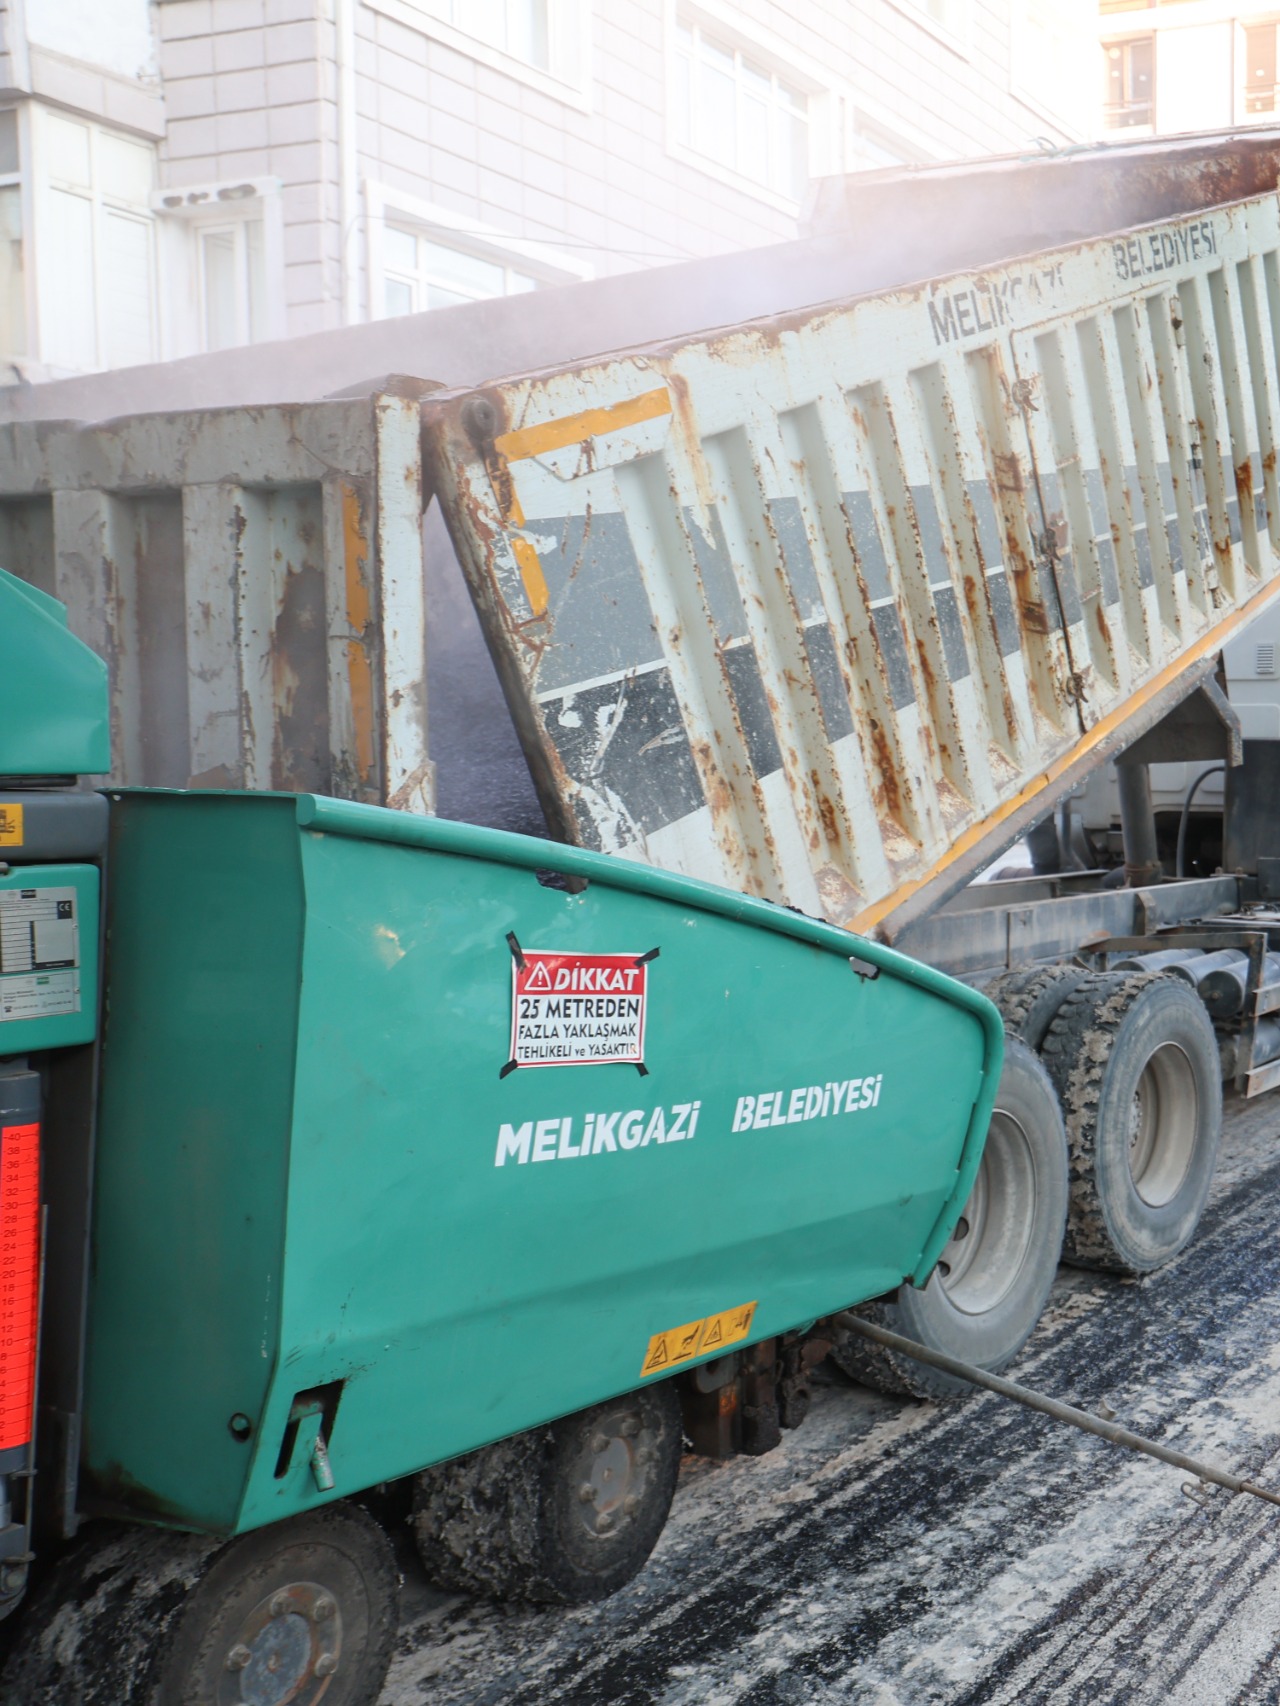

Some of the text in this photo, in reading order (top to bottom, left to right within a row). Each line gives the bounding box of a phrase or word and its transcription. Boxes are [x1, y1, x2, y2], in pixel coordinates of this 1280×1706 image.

[553, 961, 640, 991] DİKKAT
[520, 998, 640, 1019] 25 METREDEN
[518, 1022, 637, 1041] FAZLA YAKLAŞMAK
[517, 1041, 637, 1059] TEHLİKELİ ve YASAKTIR
[8, 1132, 20, 1141] 40
[7, 1146, 20, 1155] 38
[6, 1160, 20, 1169] 36
[6, 1174, 19, 1182] 34
[5, 1187, 19, 1196] 32
[5, 1201, 18, 1210] 30
[4, 1215, 18, 1224] 28
[4, 1228, 17, 1238] 26
[3, 1242, 16, 1252] 24
[2, 1256, 16, 1265] 22
[2, 1269, 16, 1279] 20
[2, 1297, 14, 1305] 16
[2, 1311, 14, 1319] 14
[1, 1324, 14, 1333] 12
[1, 1338, 13, 1346] 10
